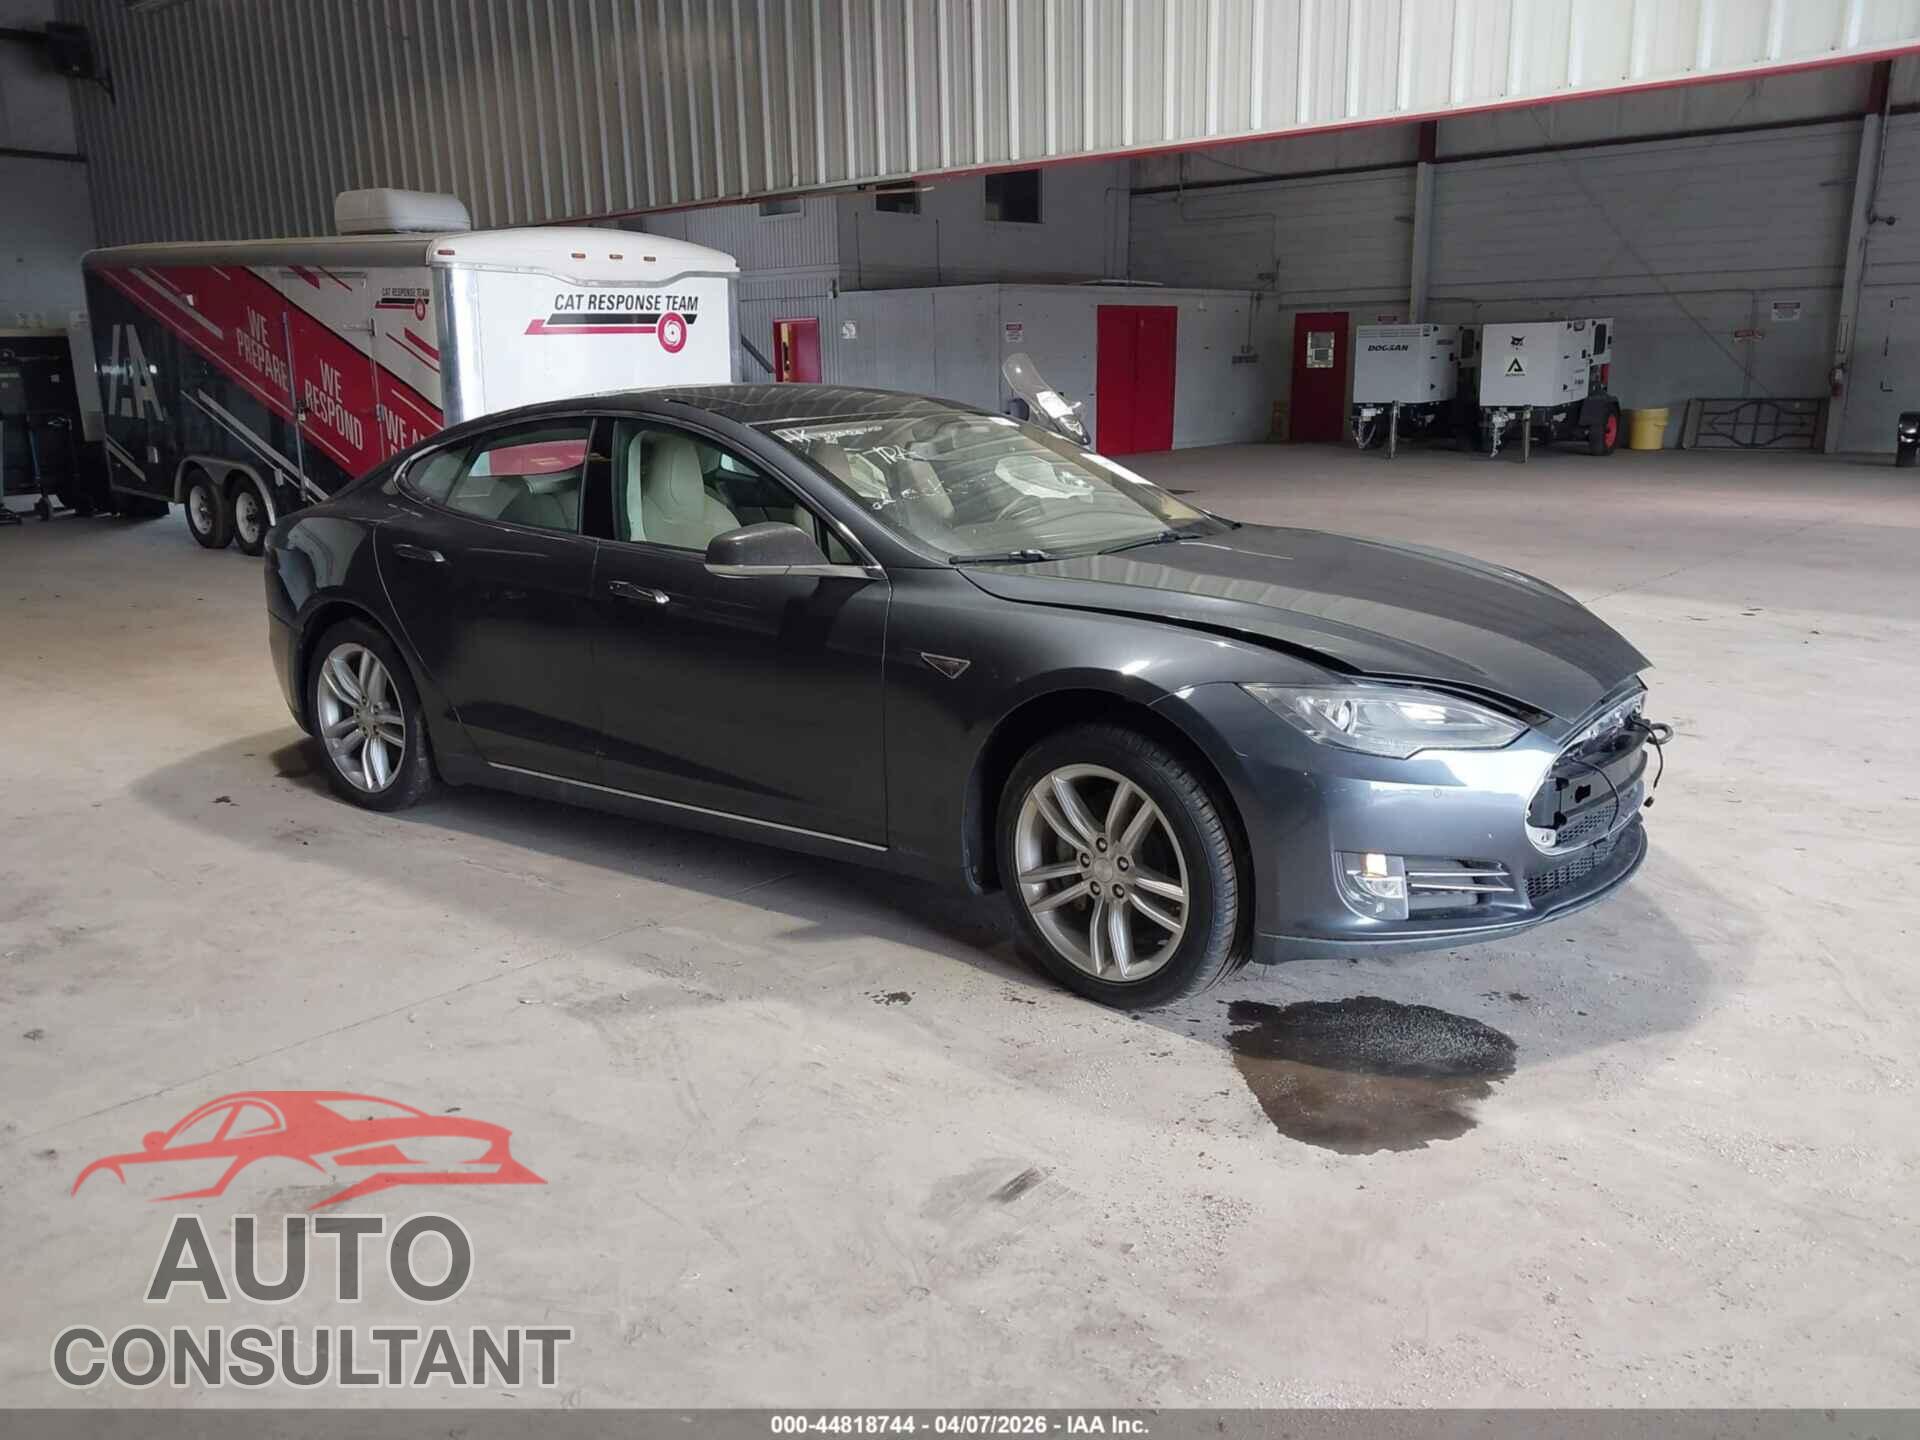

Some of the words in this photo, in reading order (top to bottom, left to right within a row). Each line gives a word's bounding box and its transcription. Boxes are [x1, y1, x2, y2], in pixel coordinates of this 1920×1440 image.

[554, 294, 584, 311] CAT
[587, 294, 661, 311] RESPONSE
[665, 295, 699, 312] TEAM
[247, 305, 271, 348] WE
[236, 327, 289, 392] PREPARE
[319, 358, 344, 404] WE
[304, 379, 363, 451] RESPOND
